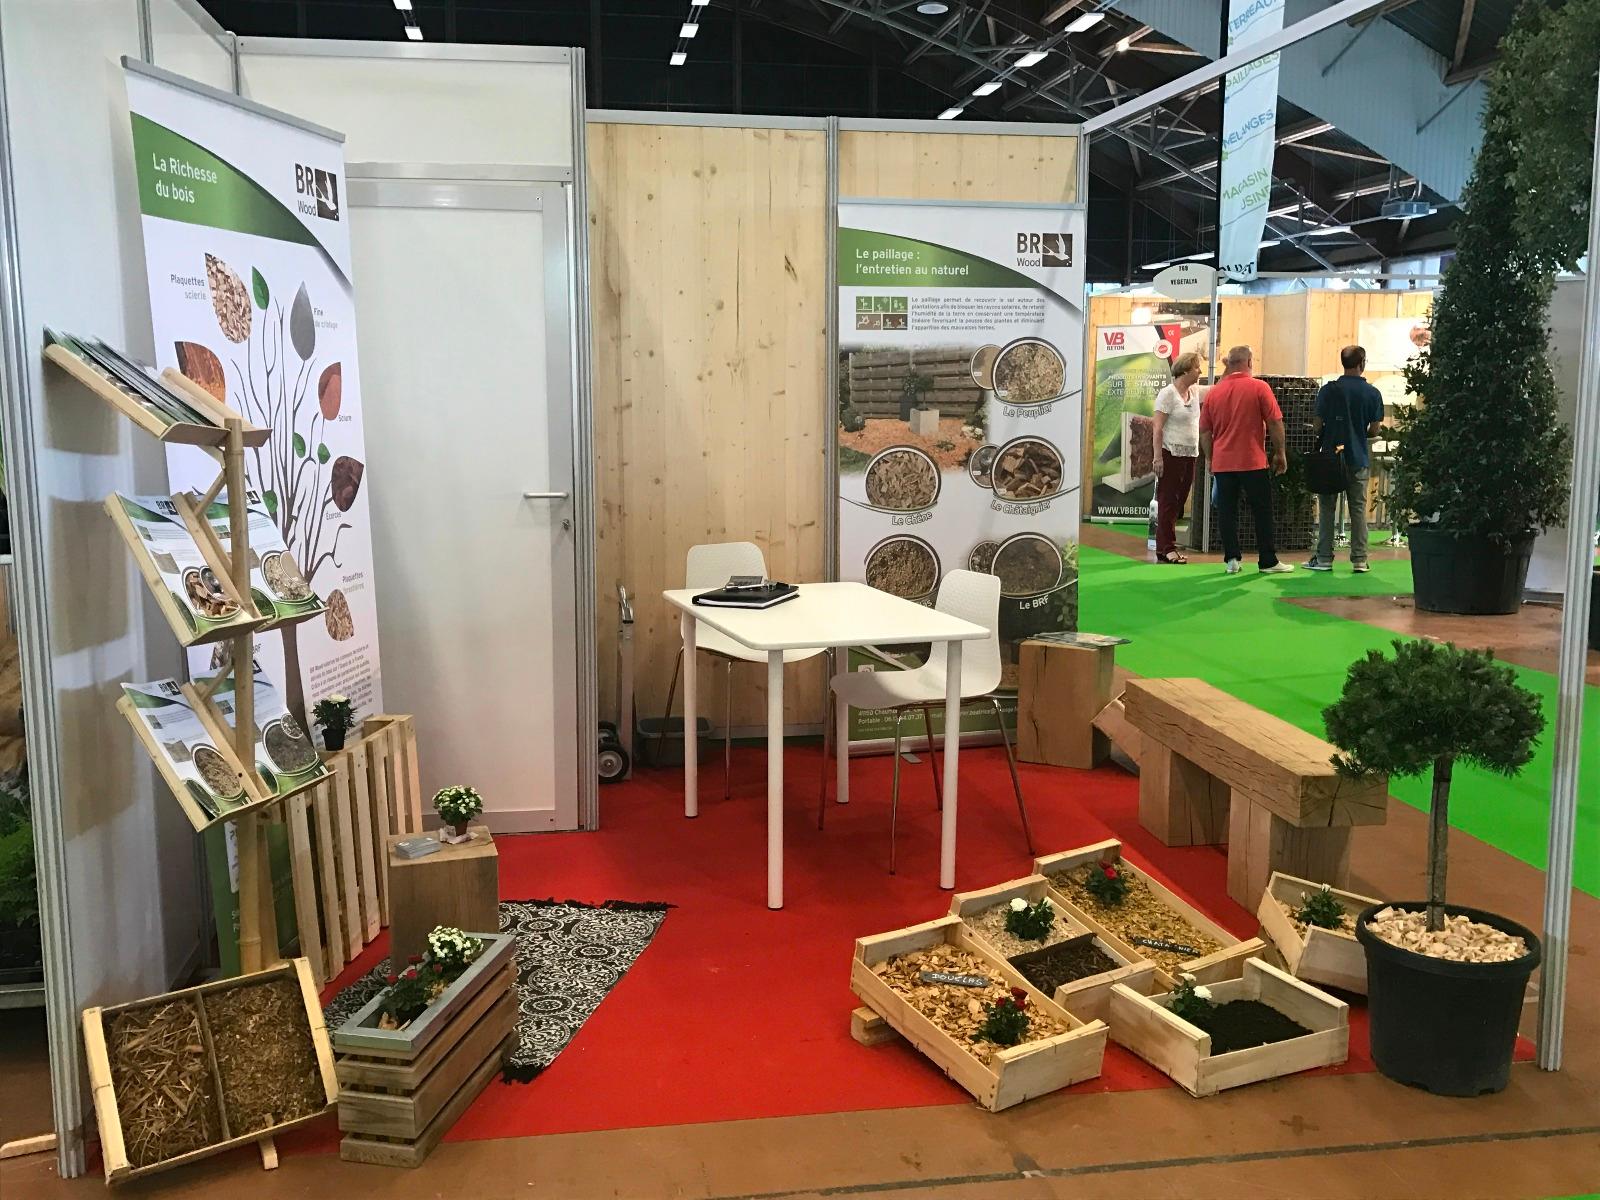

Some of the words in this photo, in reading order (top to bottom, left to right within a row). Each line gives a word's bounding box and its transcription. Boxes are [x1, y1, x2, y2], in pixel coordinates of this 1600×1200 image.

[1228, 0, 1276, 32] TERREAU
[152, 153, 166, 171] La
[170, 154, 217, 184] Richesse
[295, 163, 314, 197] BR
[156, 180, 169, 198] du
[171, 183, 195, 204] bois
[297, 200, 316, 216] Wood
[1017, 233, 1040, 254] BR
[856, 249, 869, 259] Le
[873, 249, 914, 261] paillage
[856, 264, 912, 275] l'entretien
[915, 267, 928, 275] au
[932, 265, 969, 275] naturel
[1017, 258, 1040, 267] Wood
[170, 274, 204, 286] Plaquettes
[1104, 332, 1124, 345] VB
[1003, 406, 1014, 417] Le
[1017, 404, 1052, 418] Peuplier
[991, 501, 1001, 511] Le
[1003, 501, 1050, 516] Châtaignier
[892, 516, 904, 525] Le
[905, 511, 932, 525] Chêne
[1019, 601, 1030, 610] Le
[1032, 596, 1049, 609] BRF
[932, 973, 983, 986] DOUGLAS
